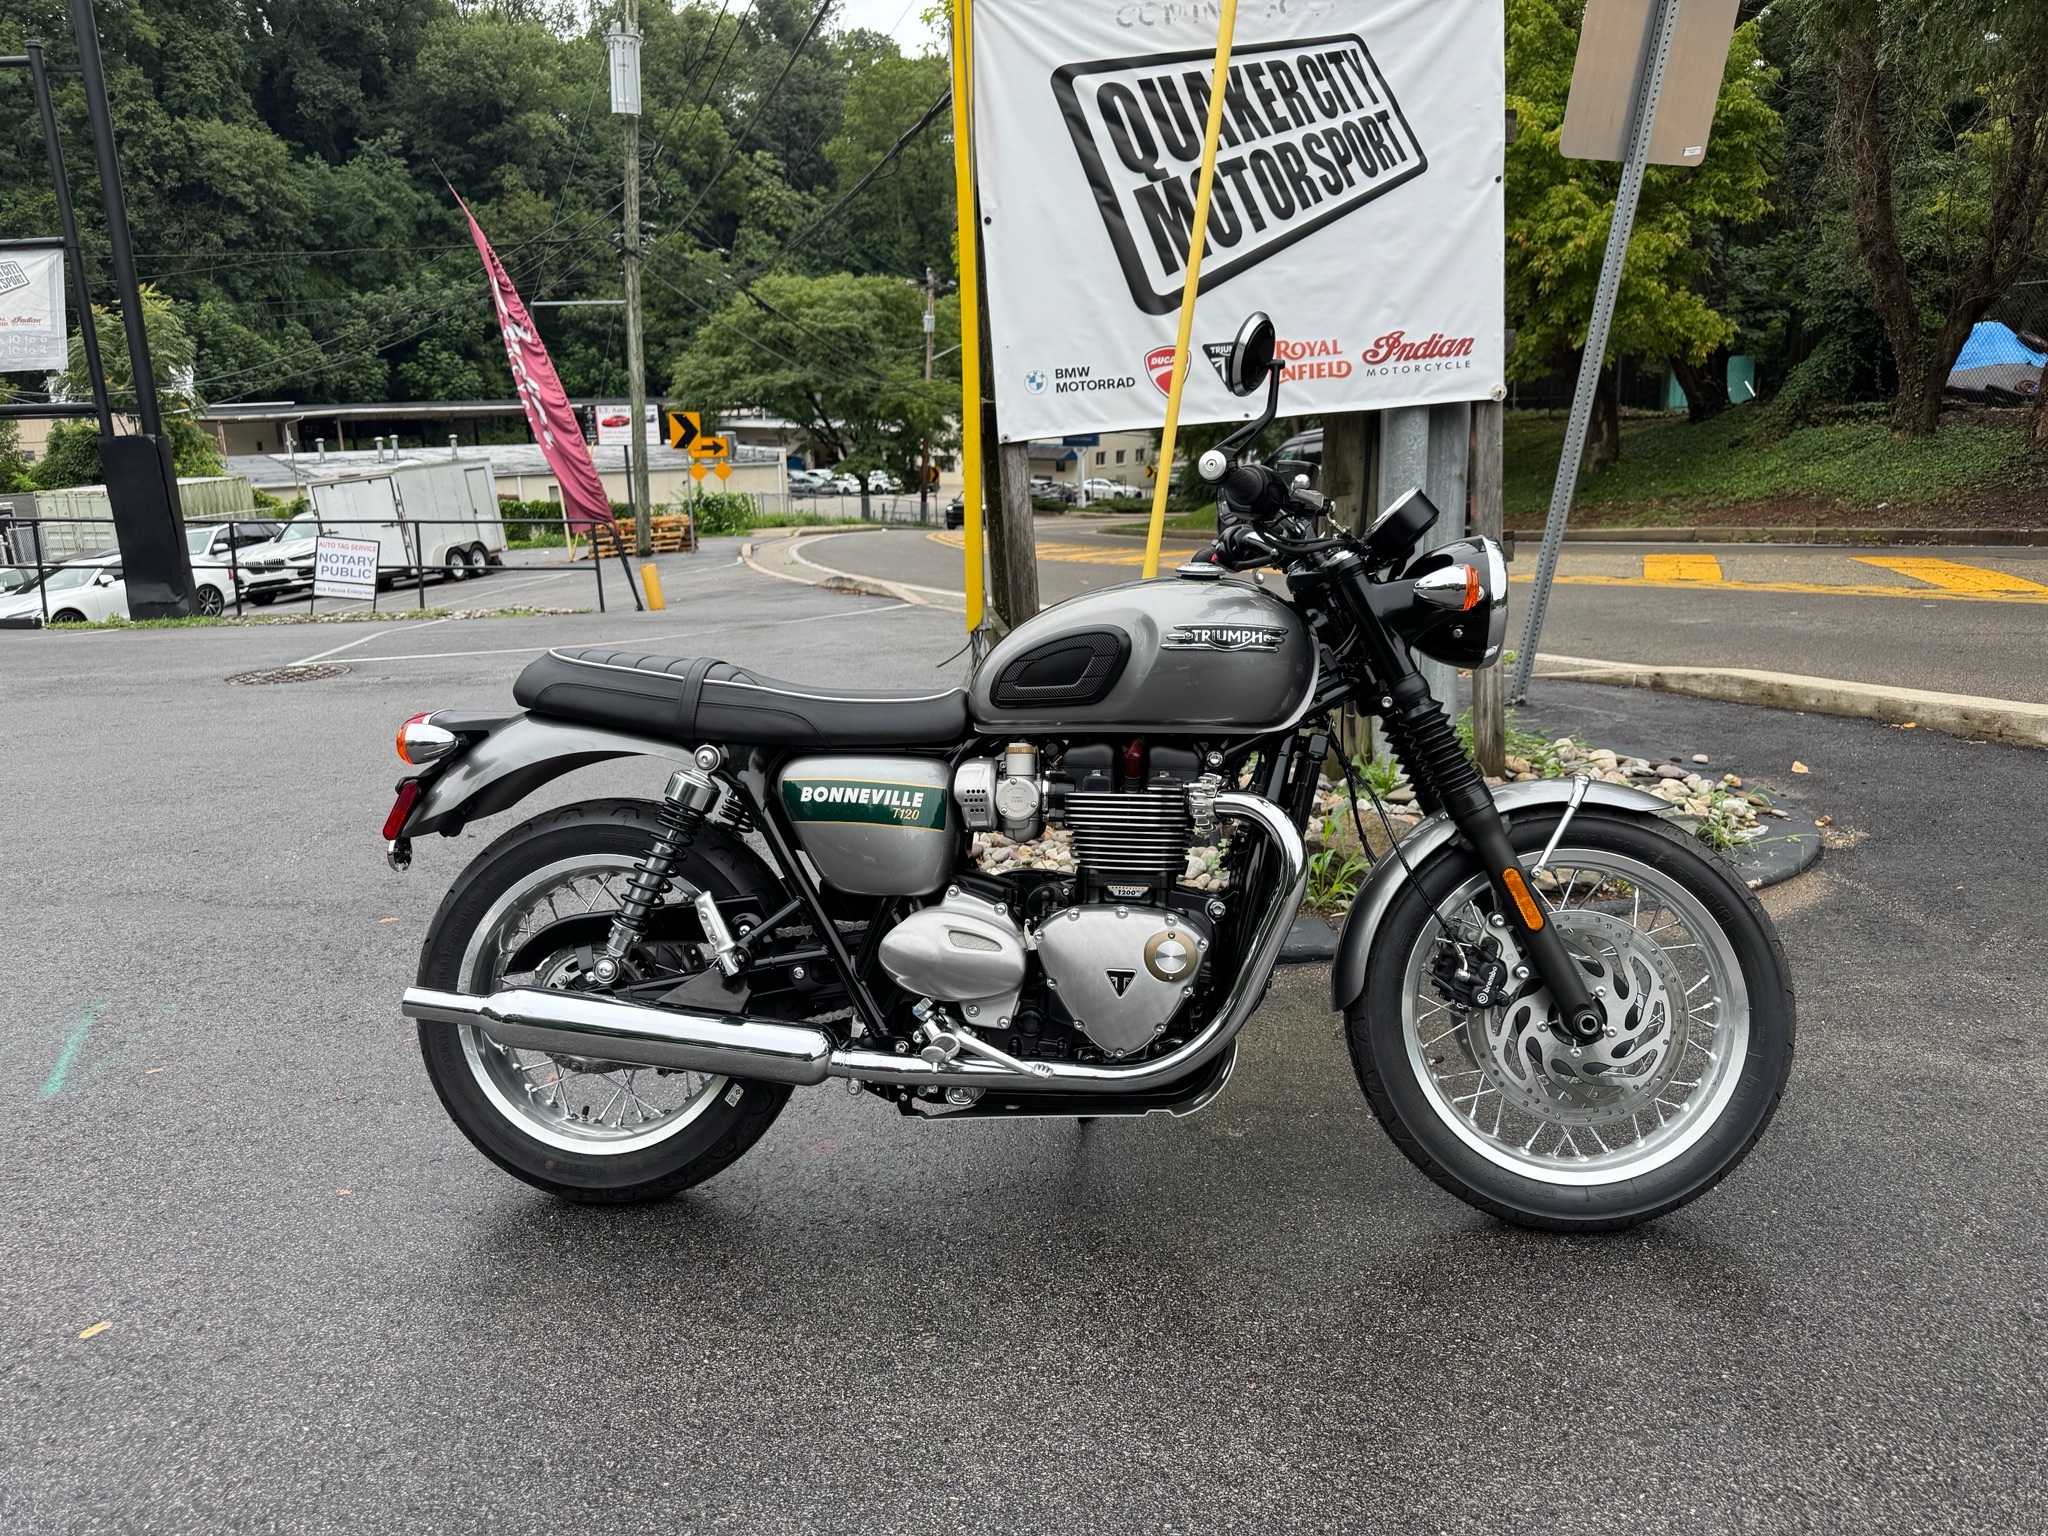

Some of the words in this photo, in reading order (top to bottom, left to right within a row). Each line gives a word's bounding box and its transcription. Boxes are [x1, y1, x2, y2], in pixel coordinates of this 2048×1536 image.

[1097, 60, 1316, 182] QUAKER
[1297, 49, 1380, 119] CITY
[1133, 110, 1408, 276] MOTORSPORT
[1210, 345, 1232, 354] TRIU
[1276, 339, 1343, 360] ROYAL
[1362, 331, 1475, 365] Indian
[1055, 366, 1090, 379] BMW
[1268, 360, 1352, 384] NFIELD
[1366, 360, 1471, 377] MOTORCYCLE
[1056, 377, 1136, 393] MOTORRAD
[319, 541, 335, 549] AUTO
[351, 544, 377, 552] SERVICE
[319, 553, 375, 567] NOTARY
[321, 566, 372, 579] PUBLIC
[1192, 629, 1263, 643] TRIUMPH
[800, 786, 924, 808] BONNEVILLE
[893, 807, 920, 820] T120
[1482, 966, 1498, 994] brembo
